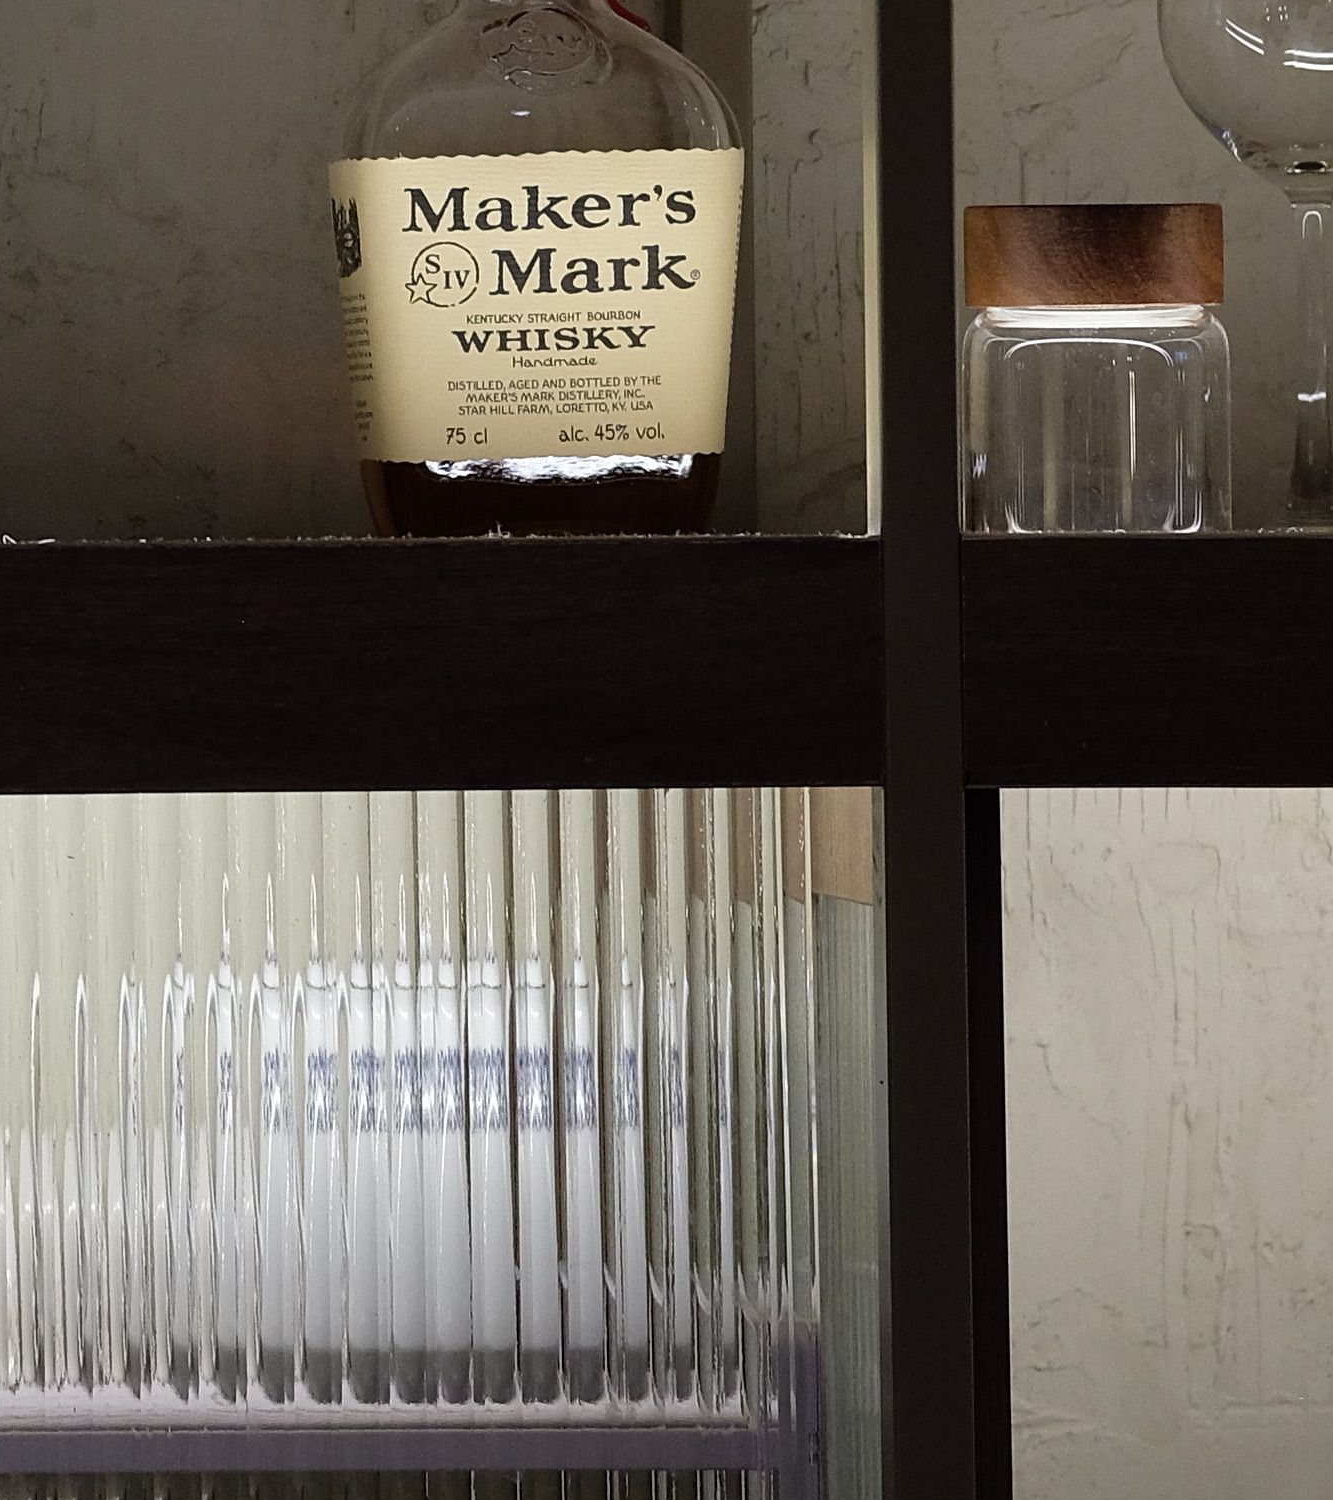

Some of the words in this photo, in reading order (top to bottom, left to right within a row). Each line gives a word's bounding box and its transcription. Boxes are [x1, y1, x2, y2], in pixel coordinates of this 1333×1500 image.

[401, 185, 696, 233] Maker's
[466, 314, 523, 324] KENTUCKY
[527, 312, 581, 323] STRAIGHT
[587, 310, 641, 321] BOURBON
[452, 326, 656, 353] WHISKY
[513, 356, 598, 368] Handmade
[448, 381, 506, 391] DISTILLED,
[508, 379, 539, 390] AGED
[542, 378, 566, 388] AND
[570, 377, 620, 388] BOTTLED
[624, 376, 638, 386] BY
[641, 375, 661, 385] THE
[466, 392, 518, 402] MAKER'S
[521, 391, 555, 401] MARK
[559, 390, 621, 401] DISTILLERY,
[624, 389, 645, 399] INC.
[458, 405, 487, 415] STAR
[490, 405, 515, 415] HILL
[517, 404, 553, 415] FARM,
[556, 403, 610, 414] LORETTO,
[631, 401, 653, 411] USA
[446, 427, 466, 444] 75
[474, 427, 488, 444] cl
[559, 426, 589, 442] alc.
[594, 424, 630, 441] 45%
[636, 422, 665, 440] vol.
